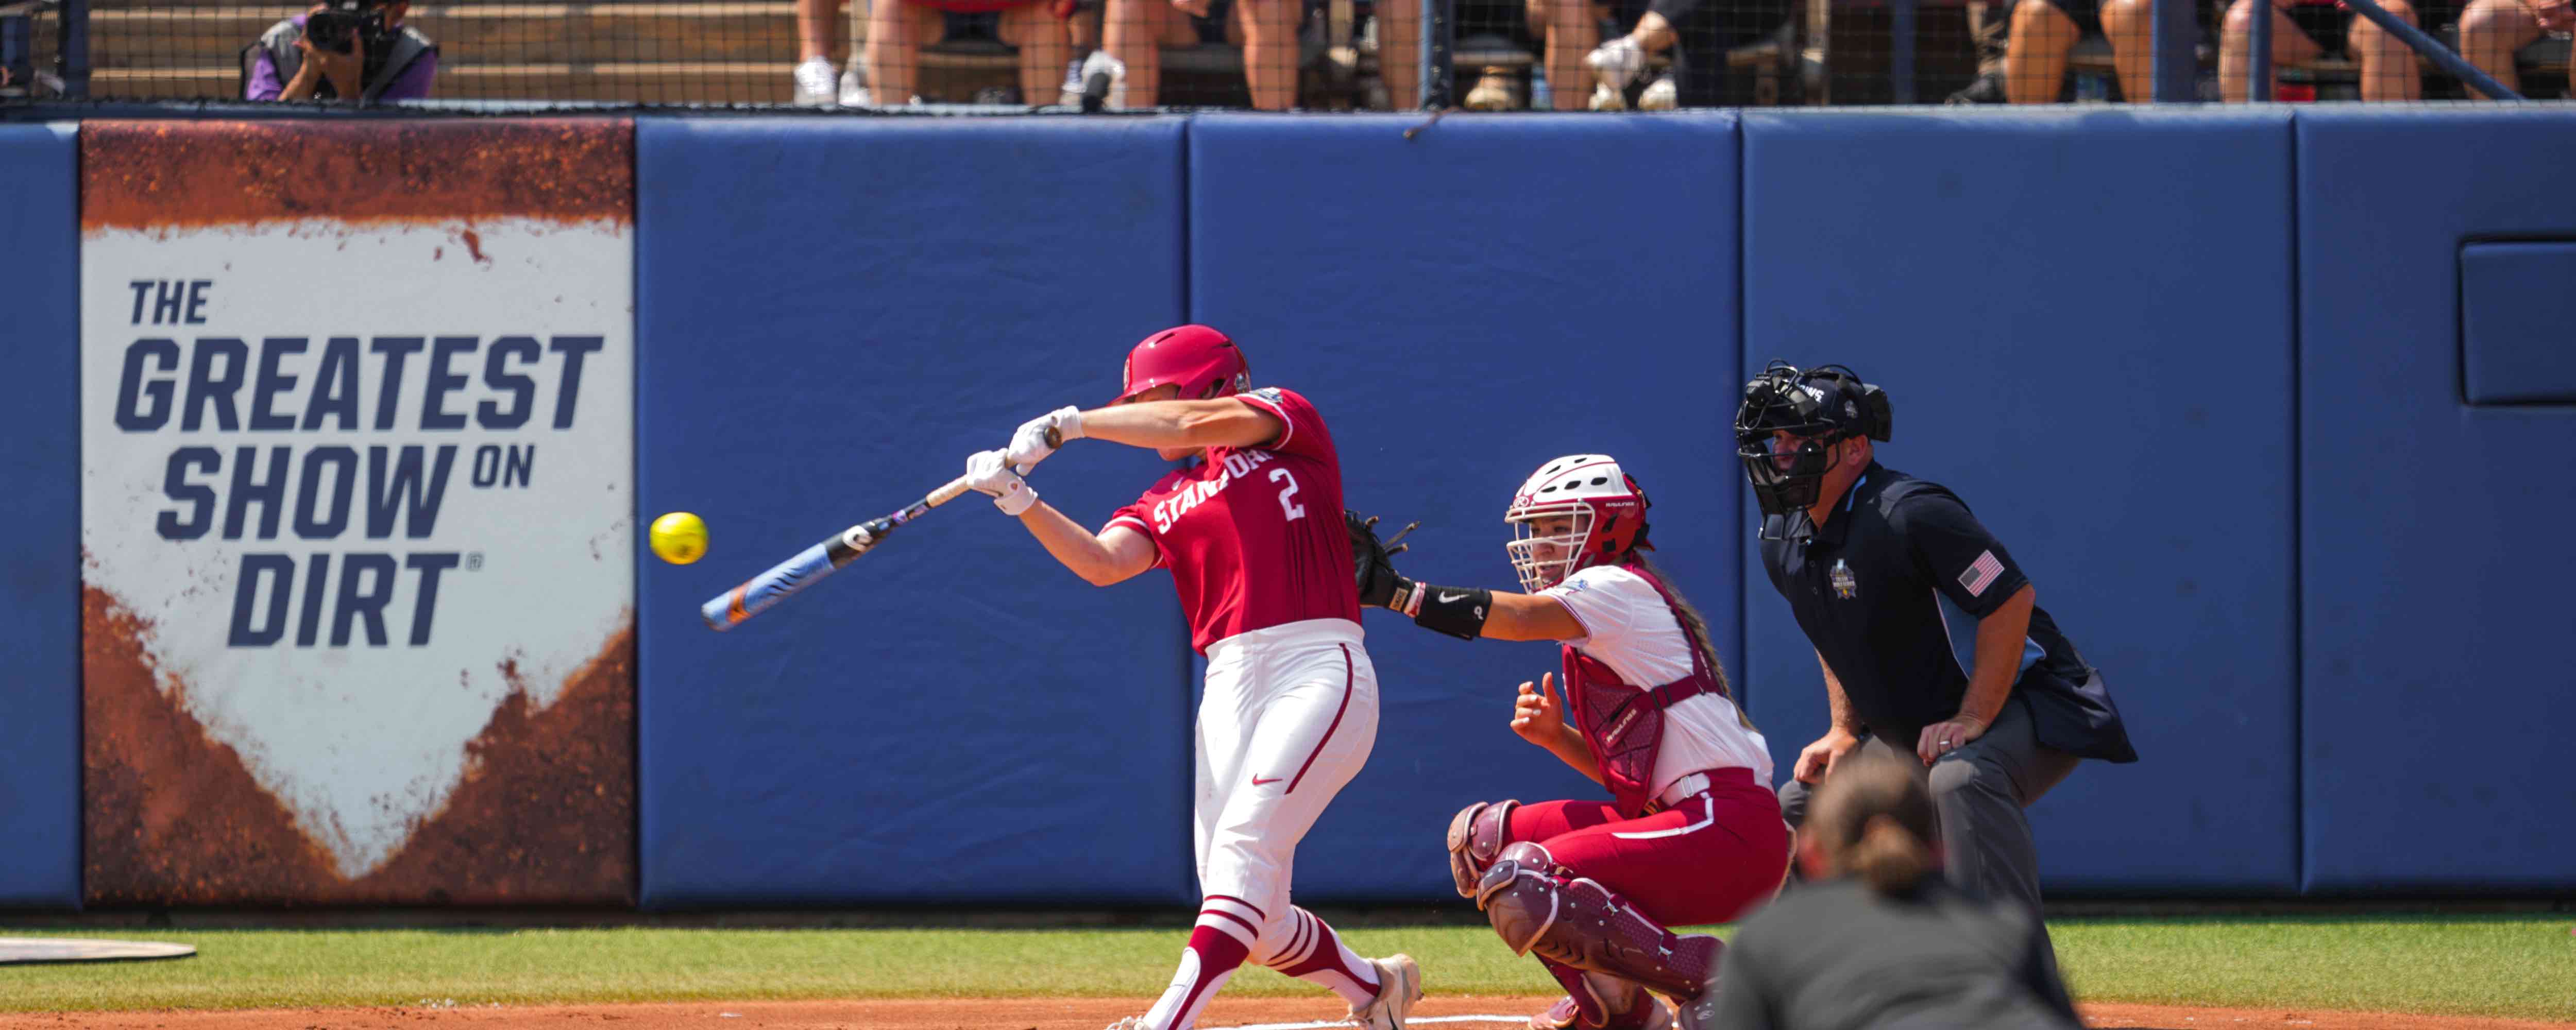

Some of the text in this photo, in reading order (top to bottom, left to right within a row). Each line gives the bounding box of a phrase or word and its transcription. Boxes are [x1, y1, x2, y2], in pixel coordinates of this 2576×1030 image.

[130, 280, 212, 325] THE
[114, 335, 604, 433] GREATEST
[156, 444, 535, 540] SHOW ON
[1268, 467, 1306, 522] 2
